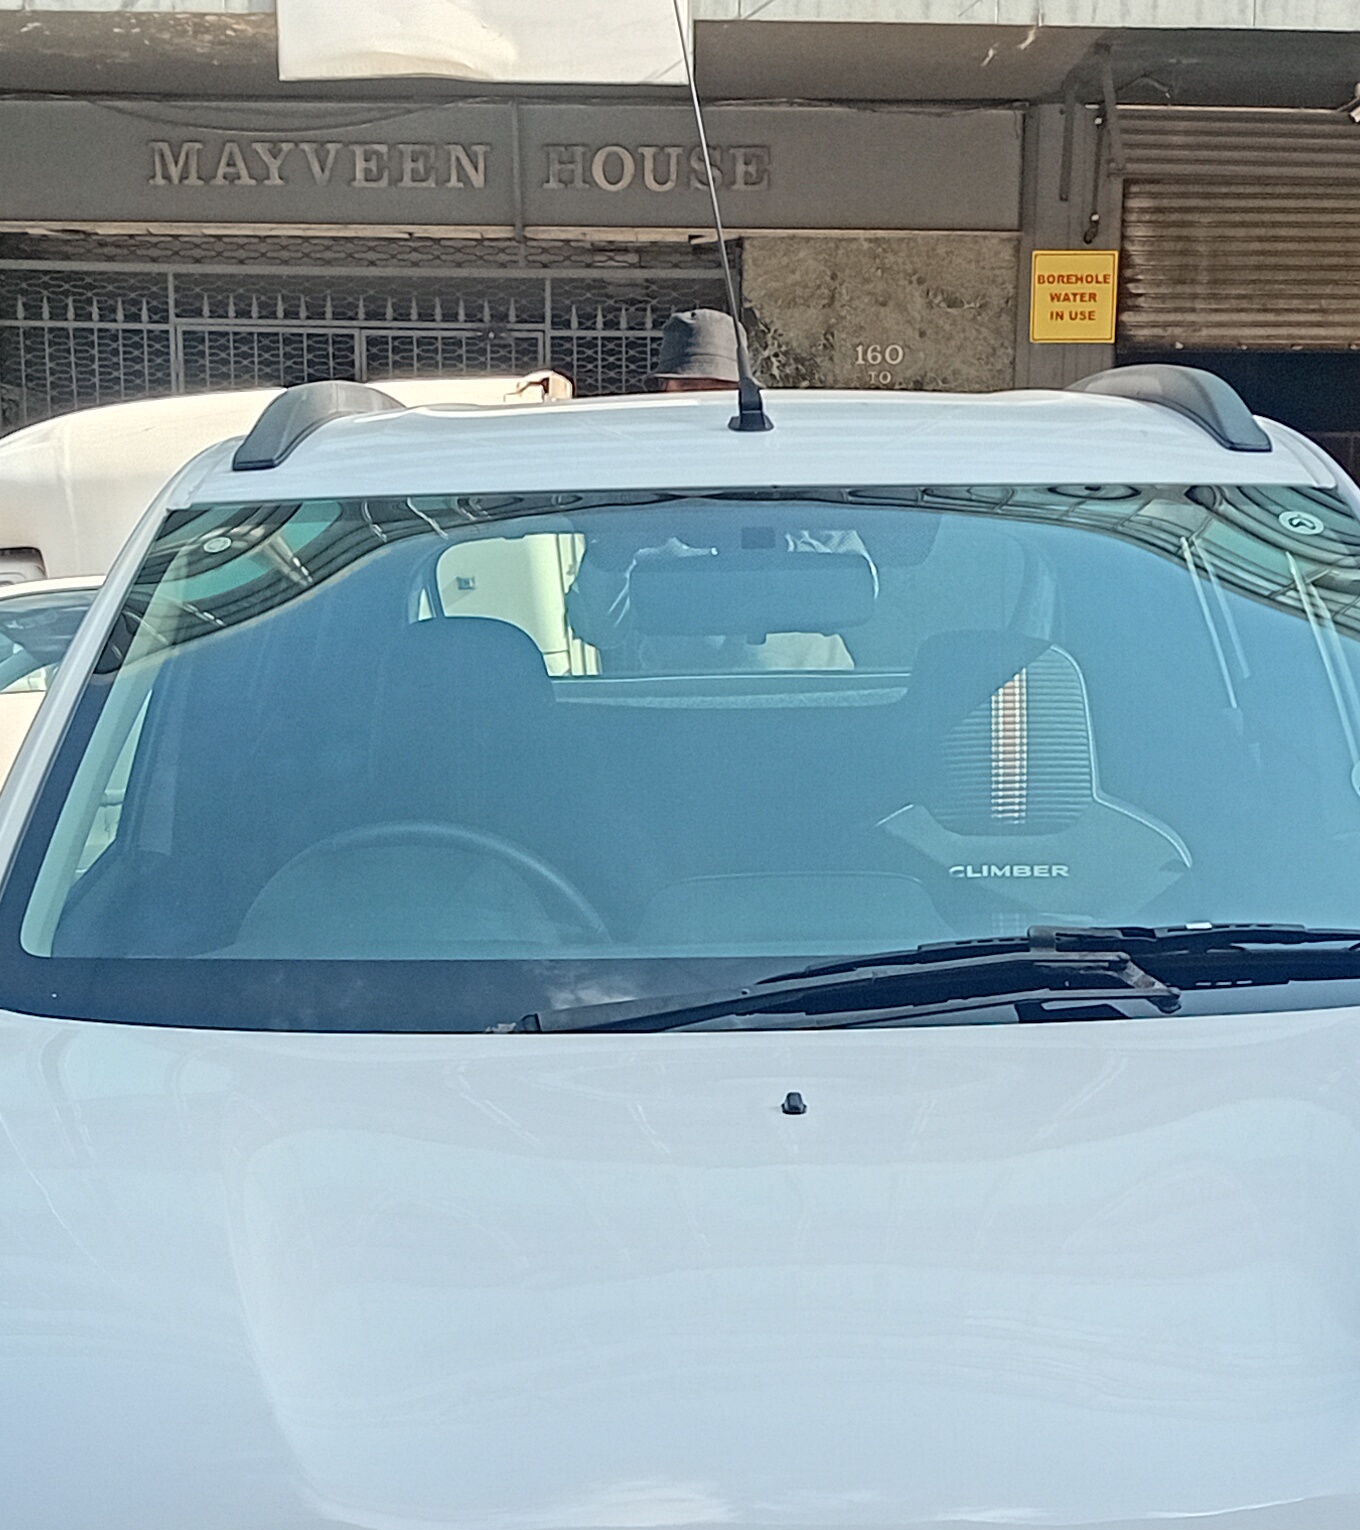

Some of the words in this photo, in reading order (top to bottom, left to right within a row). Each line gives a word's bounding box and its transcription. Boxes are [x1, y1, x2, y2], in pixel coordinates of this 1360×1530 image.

[147, 139, 491, 190] MAYVEEN
[541, 142, 772, 194] HOUSE
[1037, 273, 1111, 285] BOREHOLE
[1049, 292, 1098, 303] WATER
[1049, 310, 1064, 321] IN
[1069, 310, 1097, 321] USE
[855, 344, 904, 365] 160
[868, 371, 892, 385] TO
[948, 864, 1070, 878] CLIMBER
